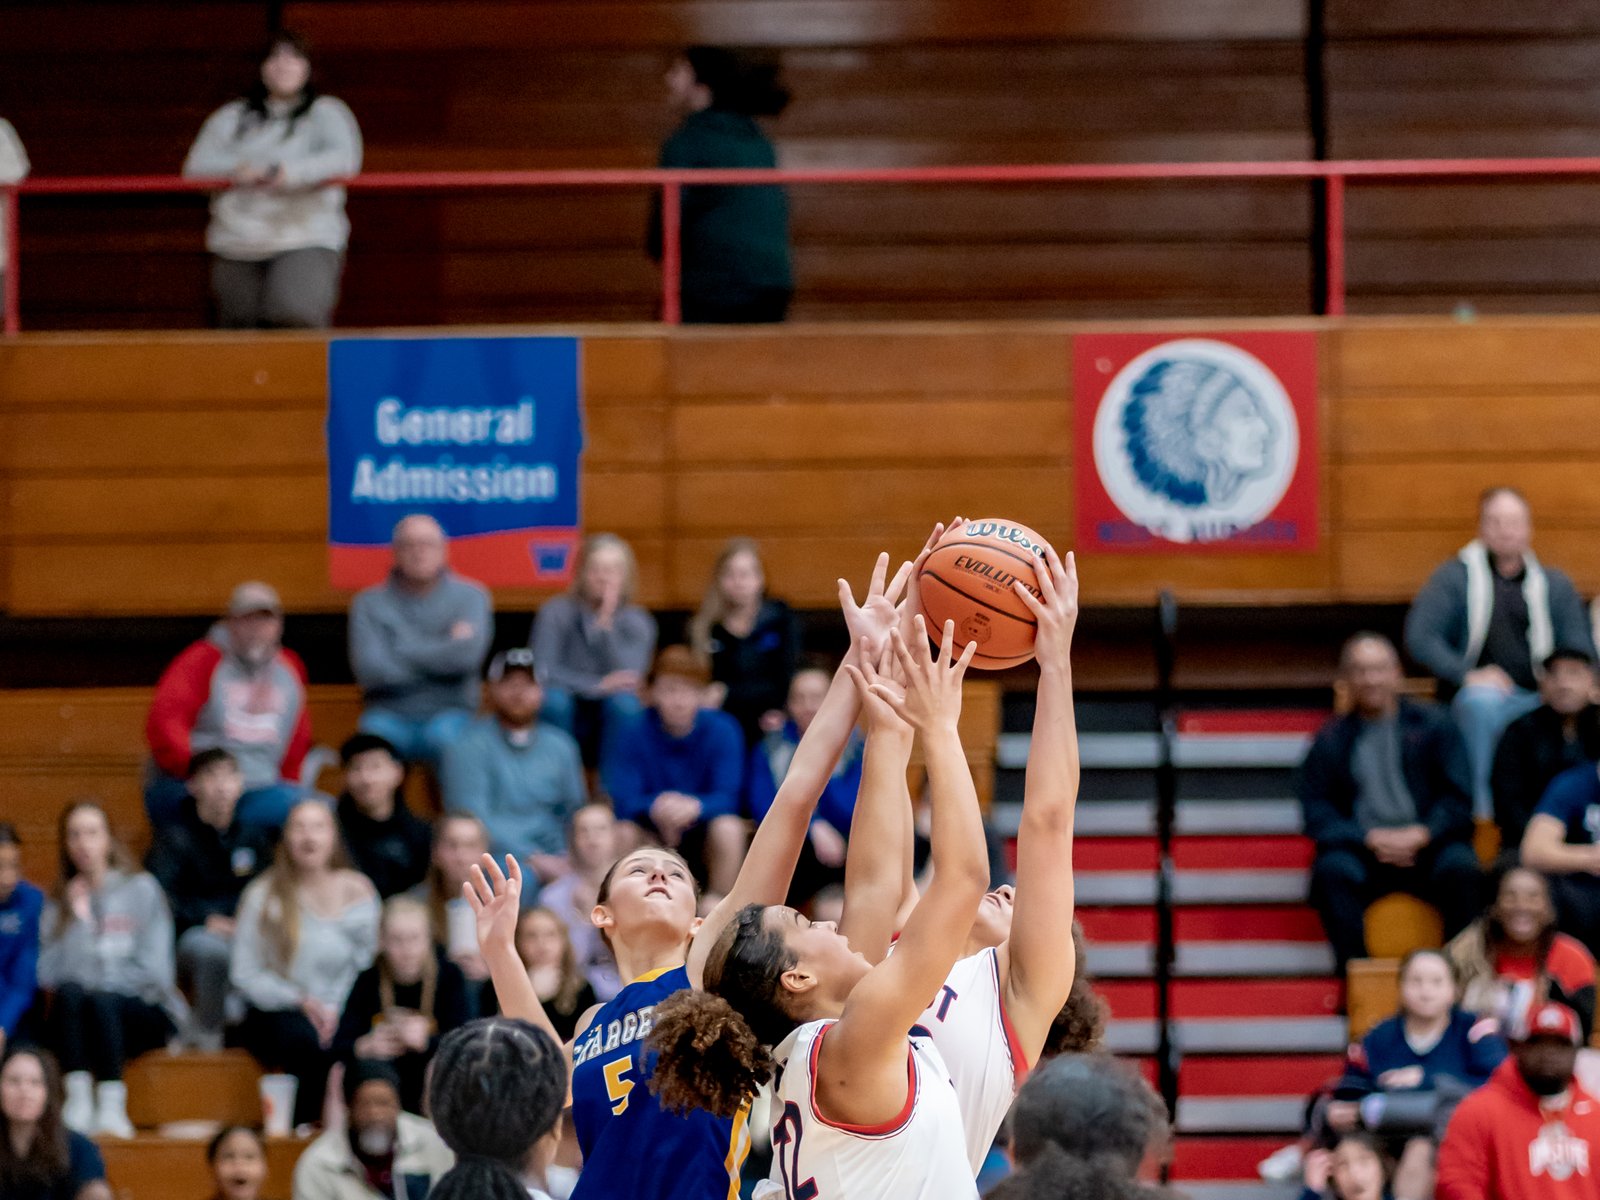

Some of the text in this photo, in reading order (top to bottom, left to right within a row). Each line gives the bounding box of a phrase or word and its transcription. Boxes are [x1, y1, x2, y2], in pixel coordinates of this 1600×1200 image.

[376, 399, 535, 444] General
[352, 459, 558, 500] Admission
[966, 522, 1046, 558] Wilso
[954, 555, 1043, 598] EVOLUTON
[603, 1054, 636, 1115] 5
